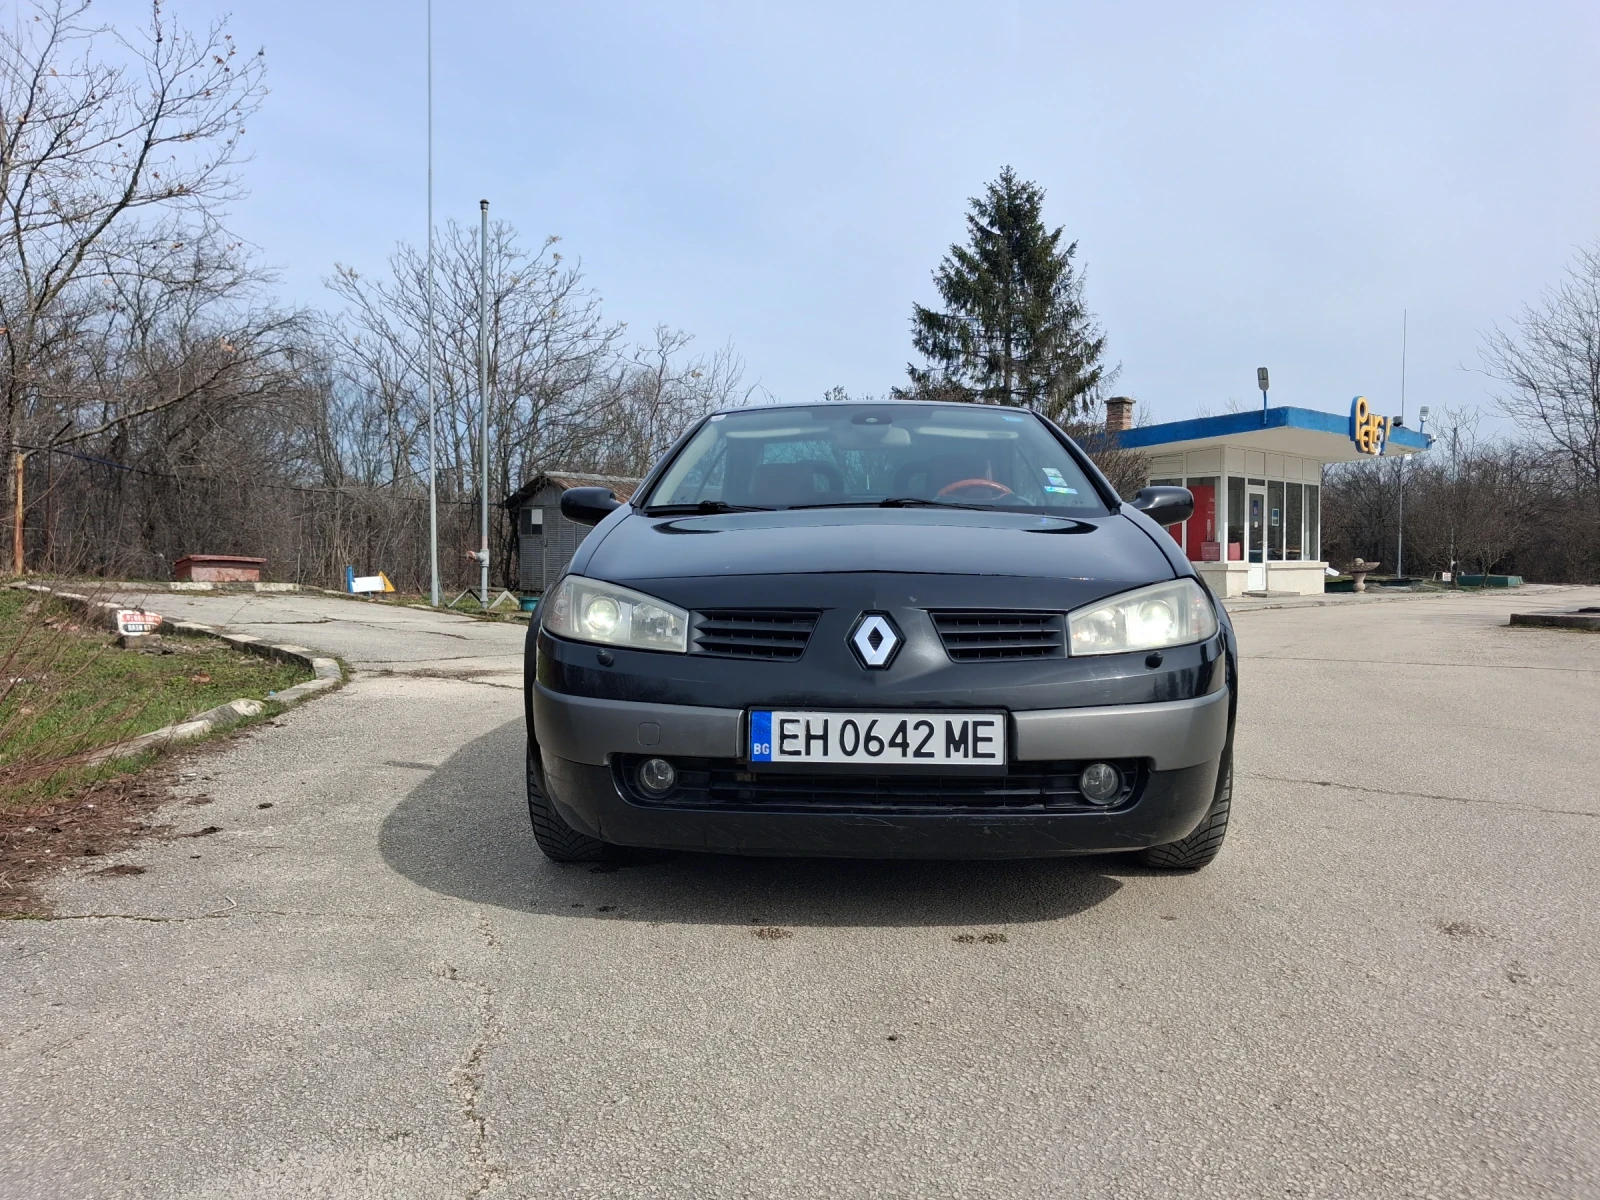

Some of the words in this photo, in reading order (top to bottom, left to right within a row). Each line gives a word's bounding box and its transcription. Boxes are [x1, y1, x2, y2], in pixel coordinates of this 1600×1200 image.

[753, 743, 770, 755] BG
[779, 718, 829, 756] EH
[839, 719, 935, 758] 0642
[945, 720, 996, 759] ME
